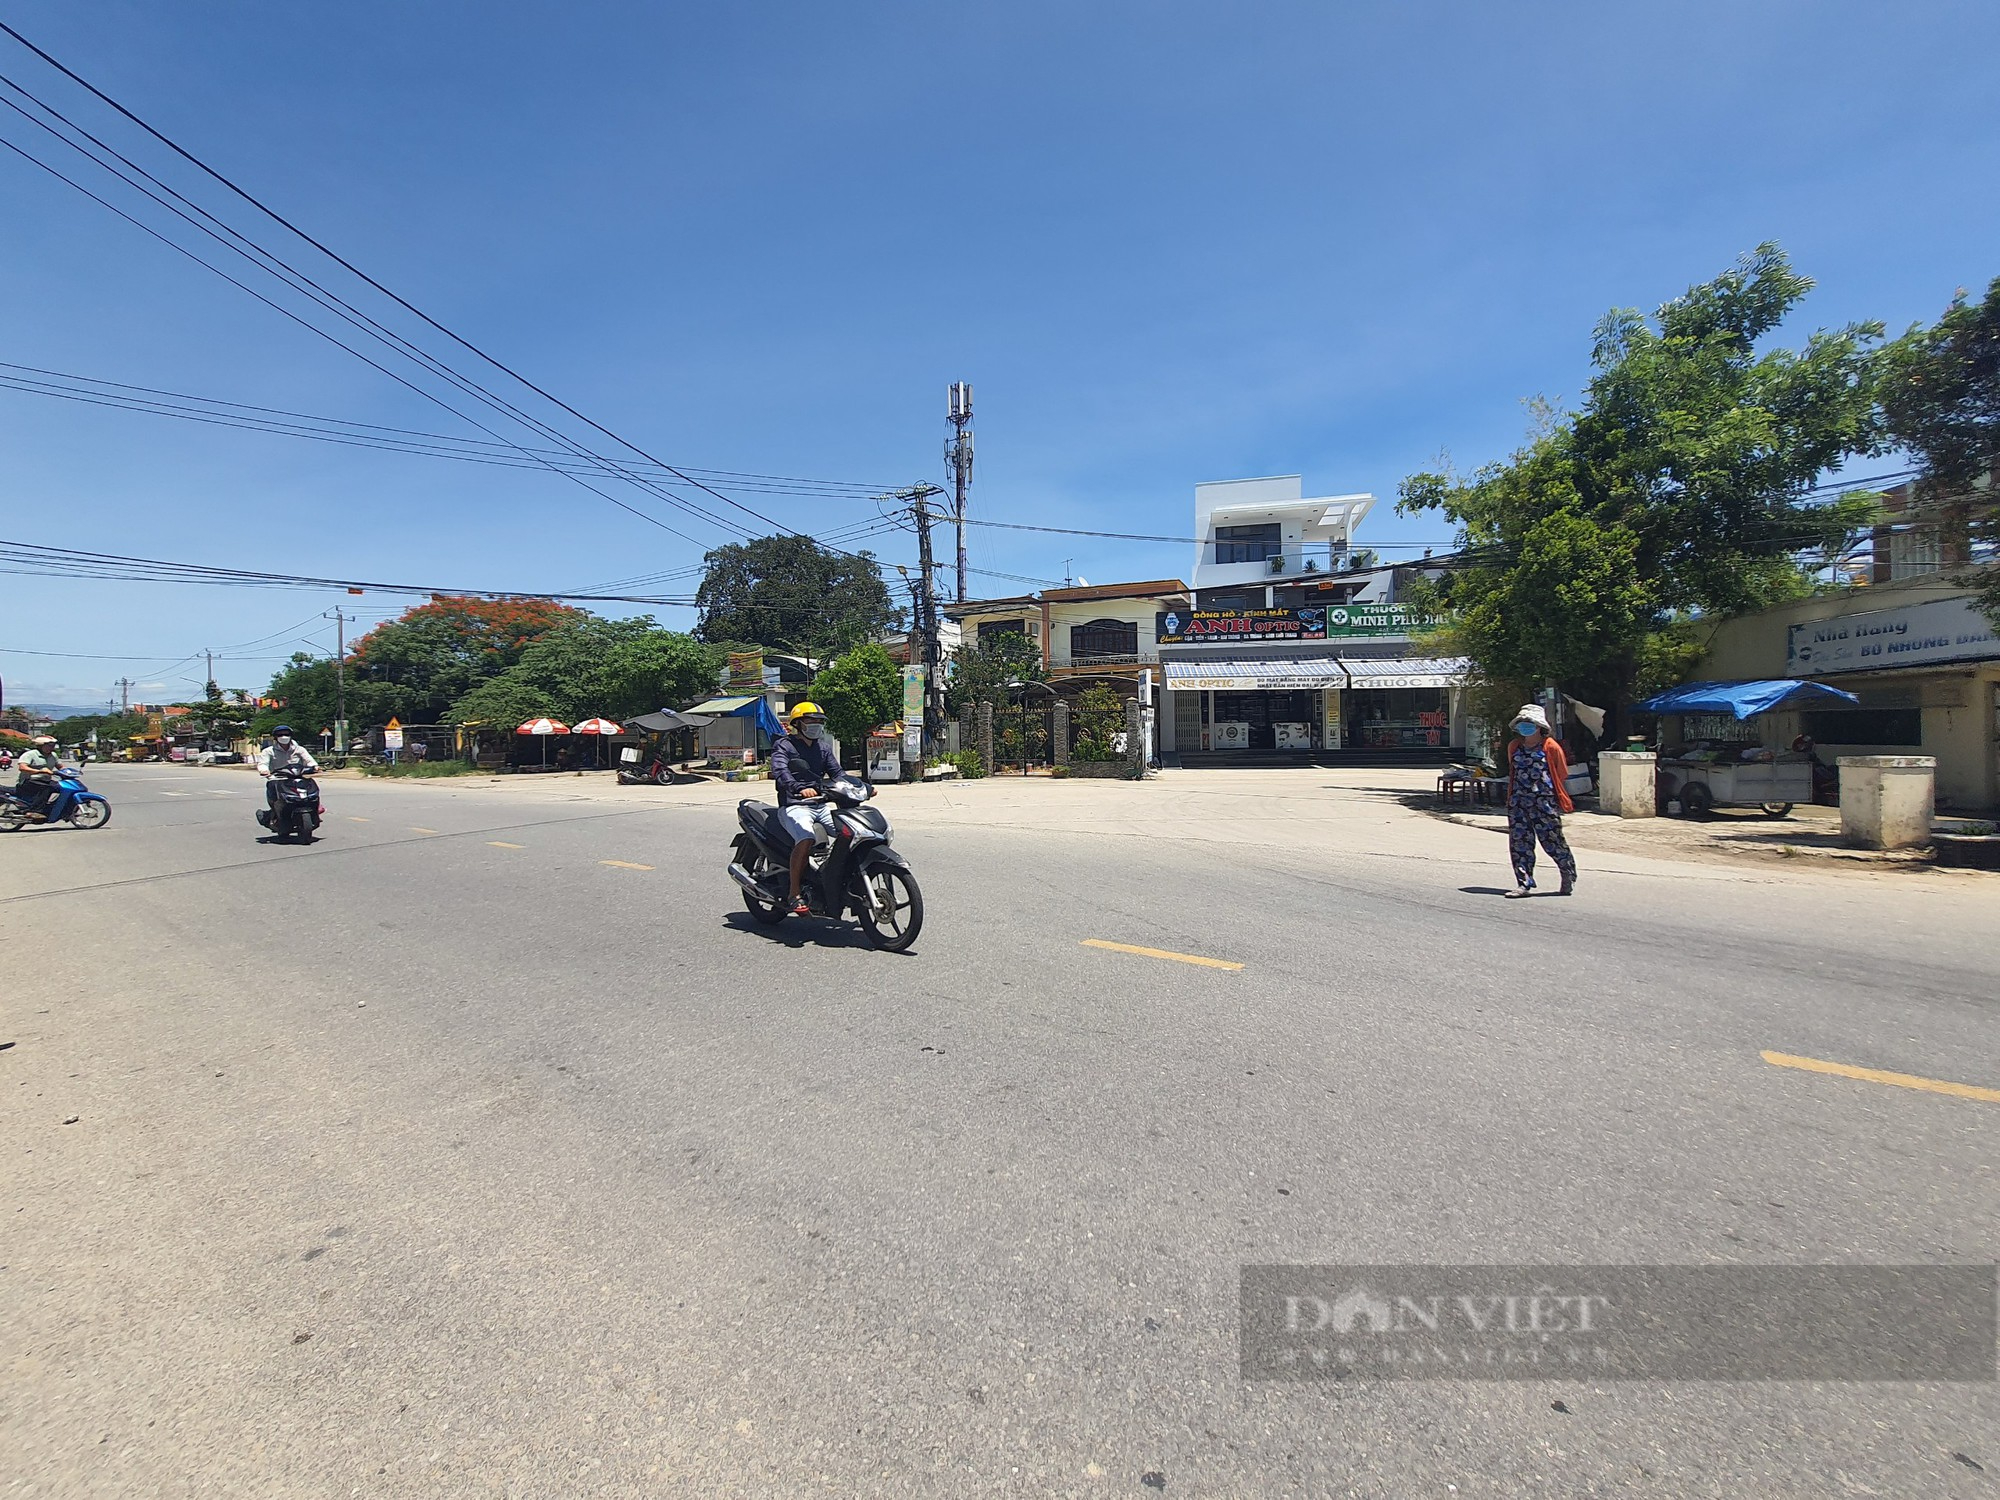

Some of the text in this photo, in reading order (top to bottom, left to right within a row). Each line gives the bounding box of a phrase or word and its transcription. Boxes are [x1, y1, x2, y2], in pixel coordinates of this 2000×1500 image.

[1221, 609, 1236, 618] HỒ
[1184, 618, 1300, 634] ANH OPTIC
[1350, 615, 1387, 627] MINH
[1169, 679, 1235, 689] ANH OPTIC
